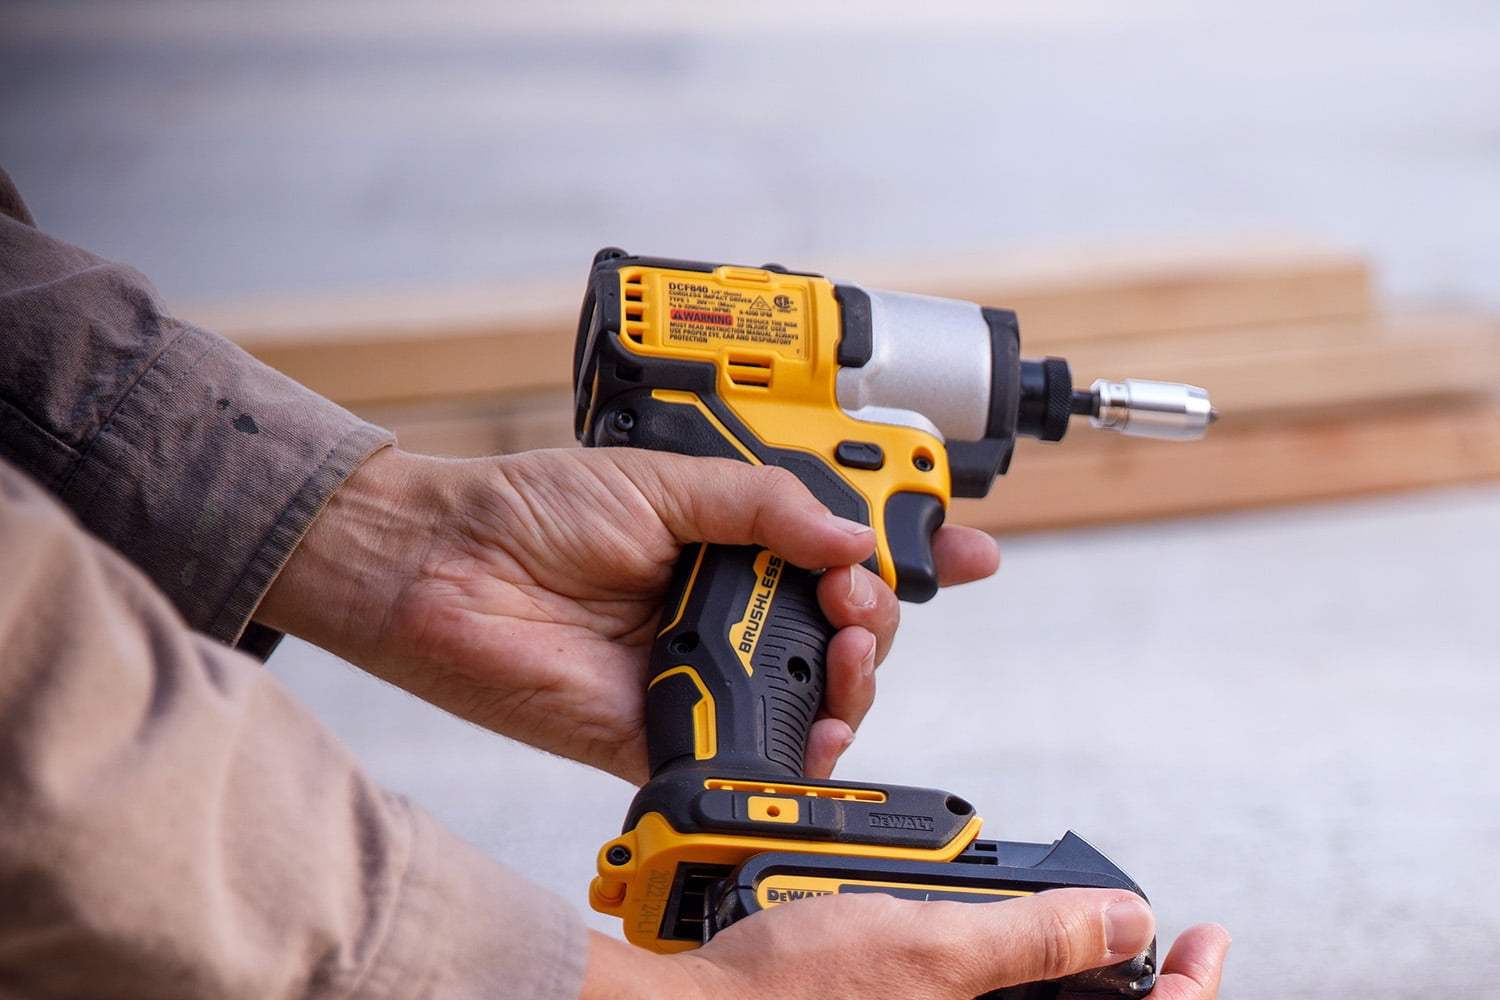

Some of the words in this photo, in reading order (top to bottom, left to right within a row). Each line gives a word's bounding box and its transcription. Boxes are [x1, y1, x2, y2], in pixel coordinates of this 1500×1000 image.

[668, 282, 709, 293] DCF840
[684, 311, 732, 326] WARNING
[739, 555, 782, 653] BRUSHLESS
